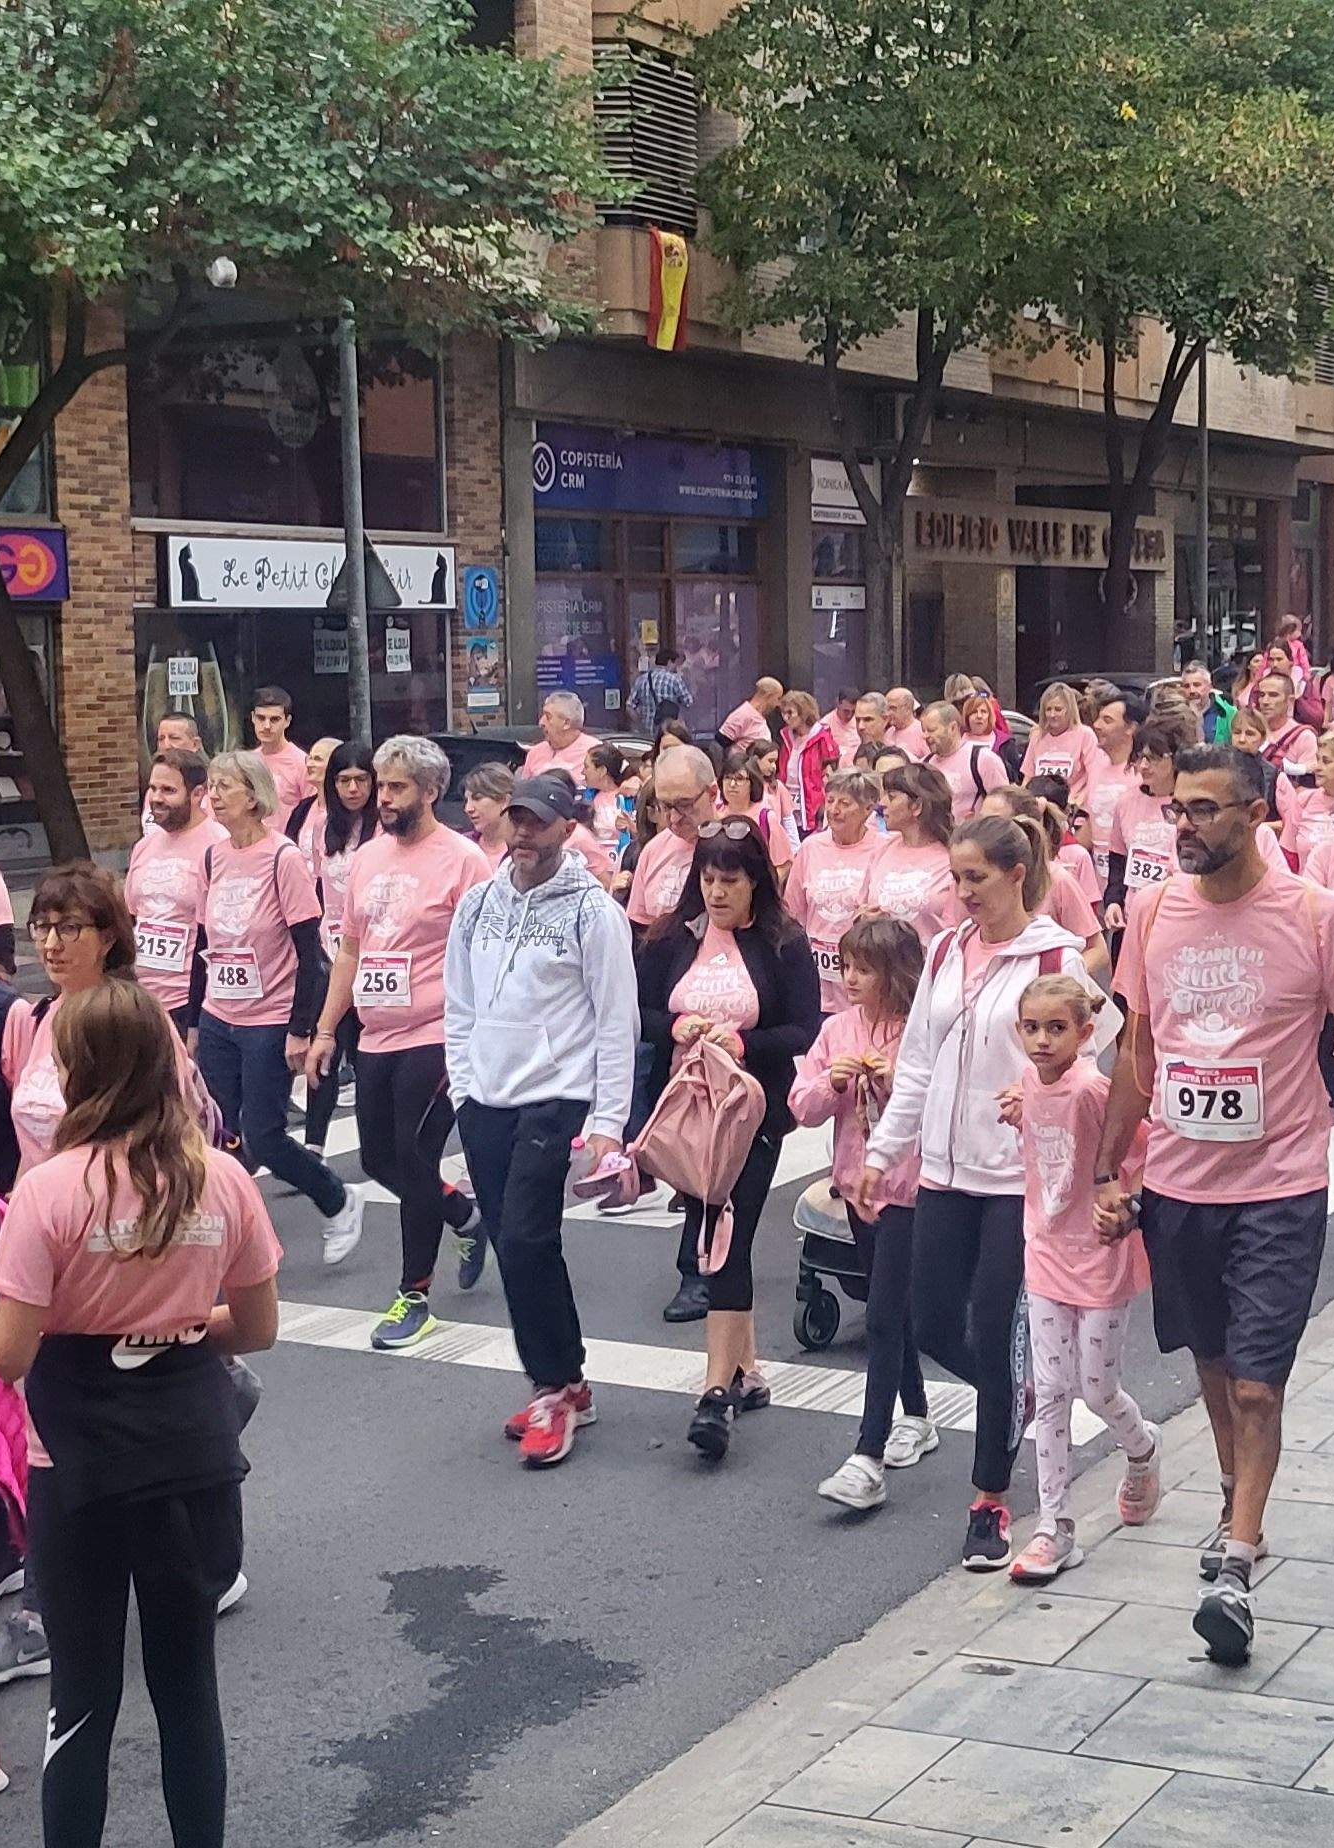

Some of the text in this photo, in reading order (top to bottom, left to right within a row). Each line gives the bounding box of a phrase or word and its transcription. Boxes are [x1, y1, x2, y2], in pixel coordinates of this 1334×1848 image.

[560, 450, 623, 470] COPISTERÍA
[560, 473, 585, 489] CRM
[916, 510, 1000, 553] EDIFICIO
[1006, 517, 1067, 559] VALLE
[1071, 523, 1097, 560] DE
[222, 558, 250, 588] Le
[254, 556, 309, 592] Petit
[136, 934, 182, 959] 2157
[217, 966, 249, 986] 488
[362, 971, 398, 993] 256
[1170, 1071, 1253, 1085] CONTRA EL CÁNCER
[1178, 1086, 1244, 1120] 978
